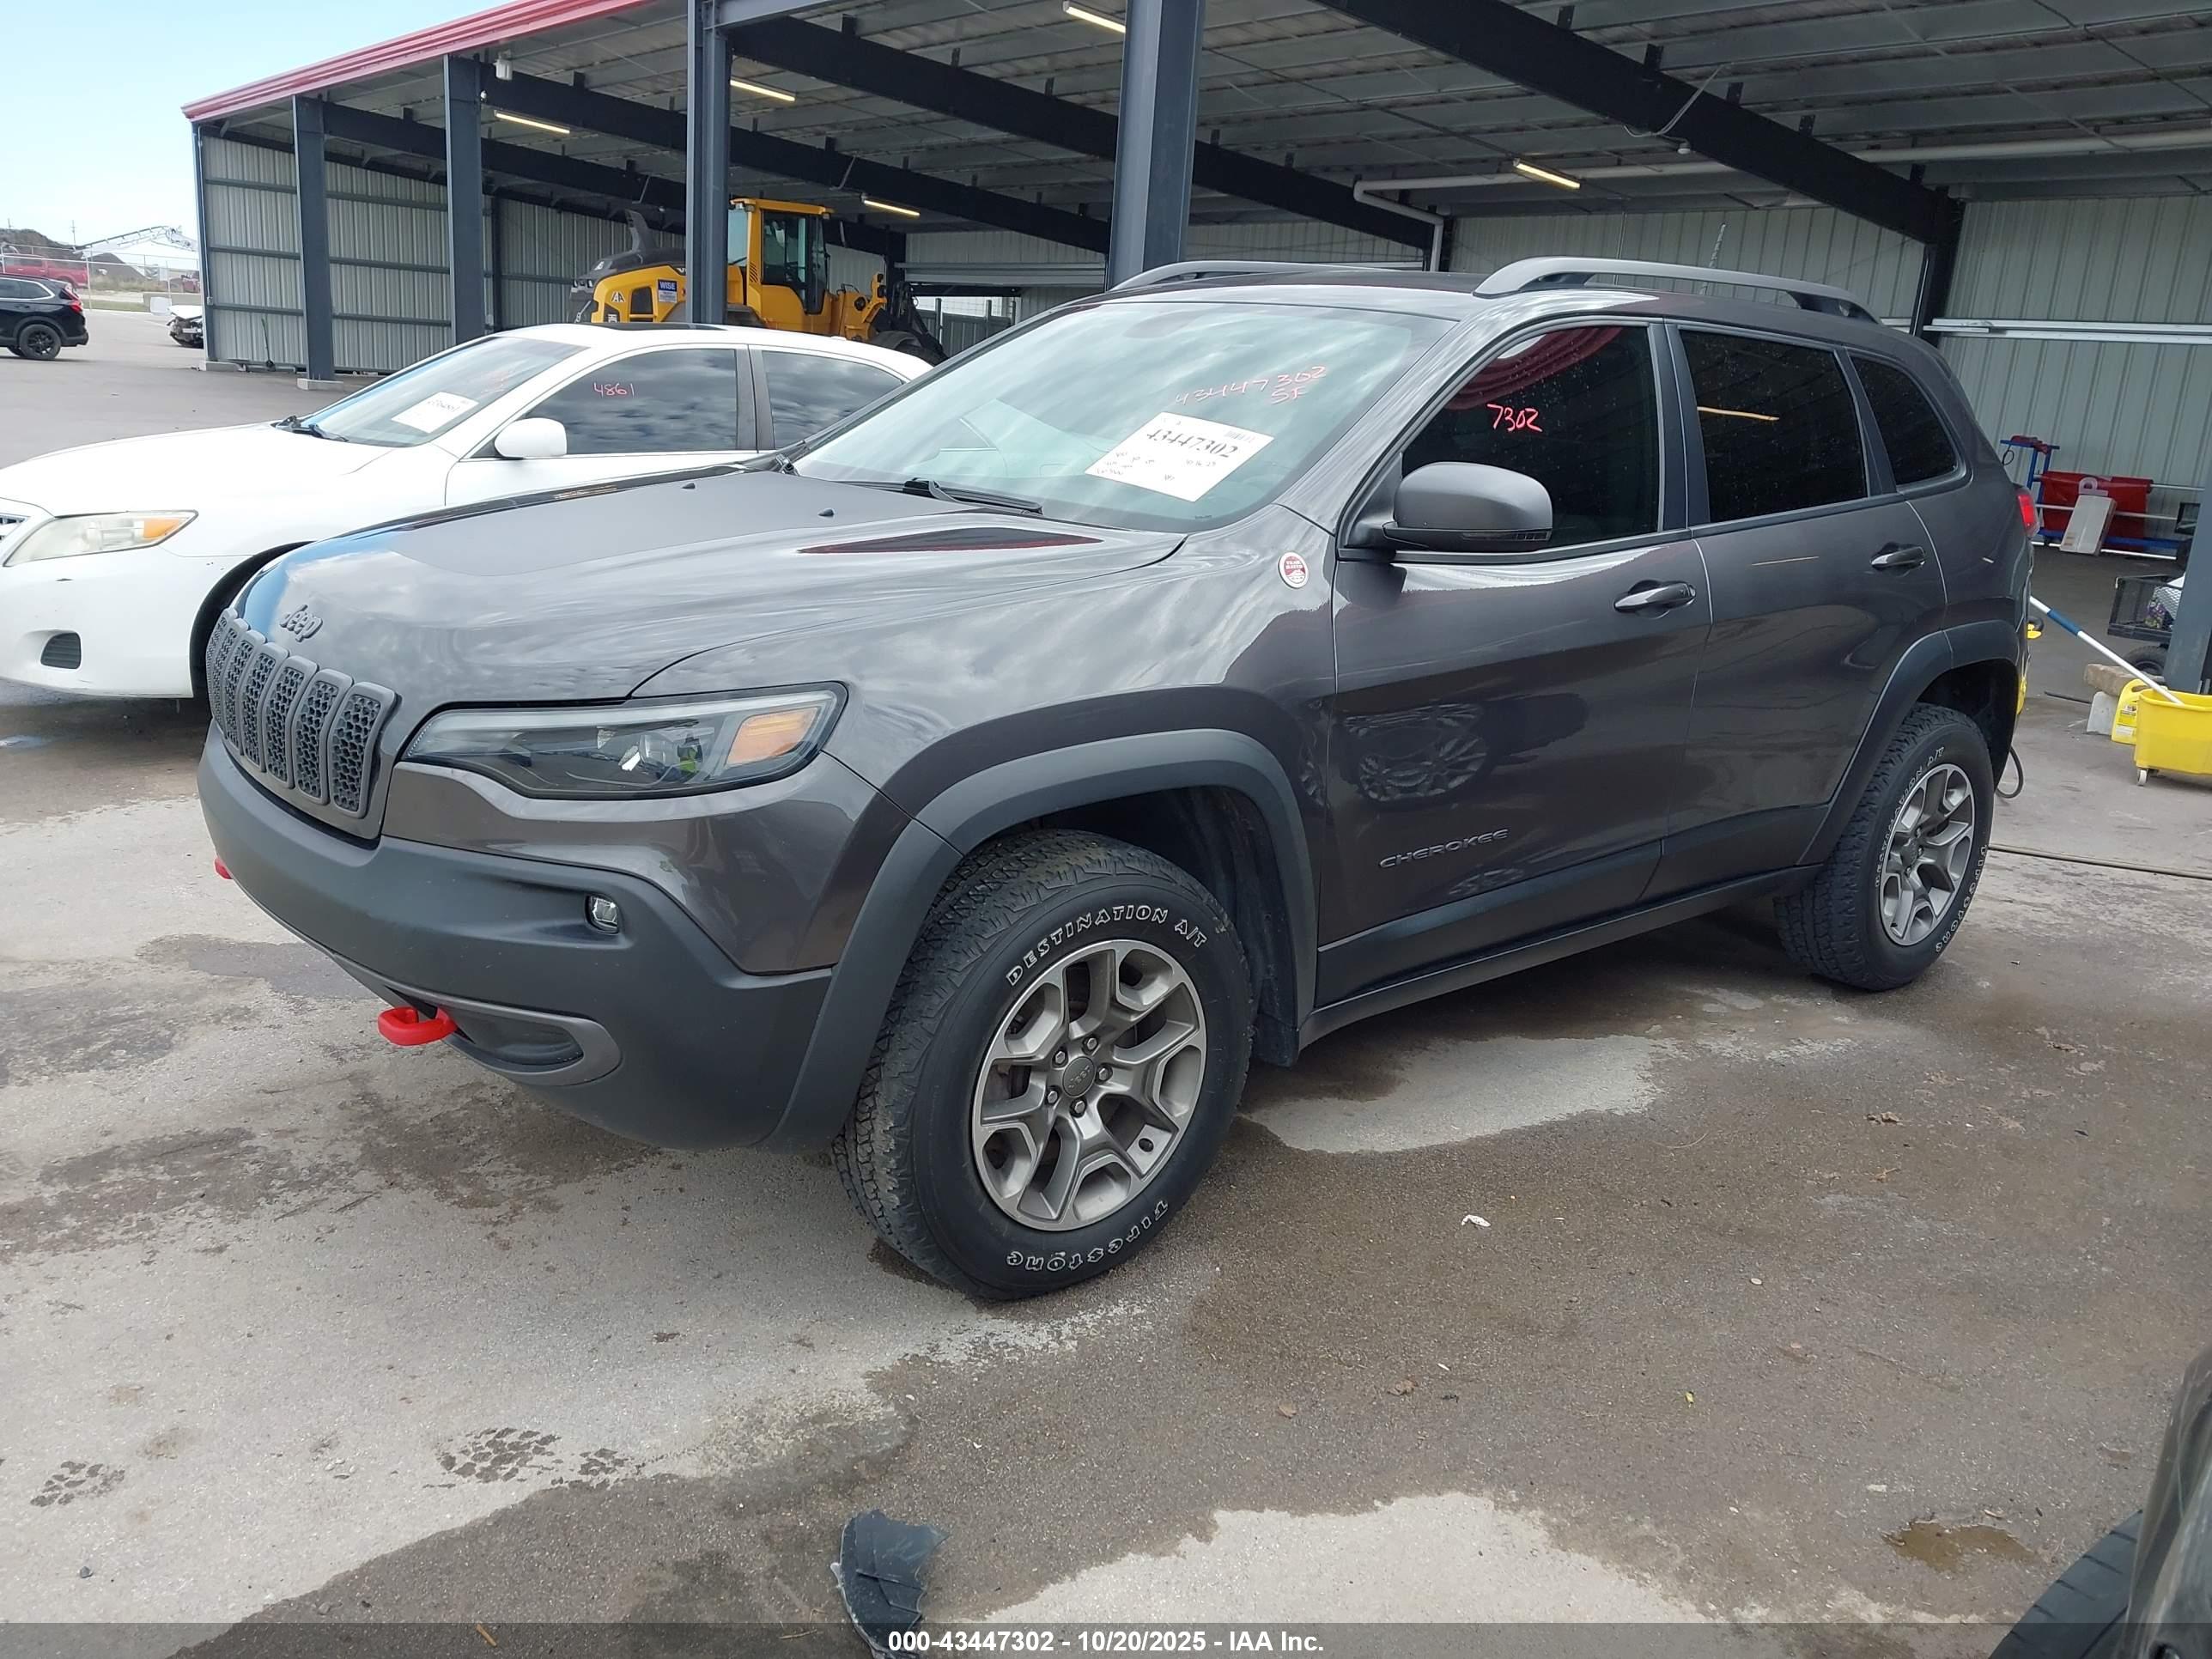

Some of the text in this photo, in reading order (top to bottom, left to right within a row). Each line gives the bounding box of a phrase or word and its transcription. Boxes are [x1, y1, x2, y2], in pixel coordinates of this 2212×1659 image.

[659, 281, 676, 290] WISE
[593, 383, 635, 398] 4861
[1175, 366, 1326, 405] 43447302
[1486, 403, 1543, 432] 7302
[1146, 428, 1238, 458] 43447302
[1379, 829, 1509, 868] CHEROKEE
[1006, 905, 1208, 986] DESTINATION A/T
